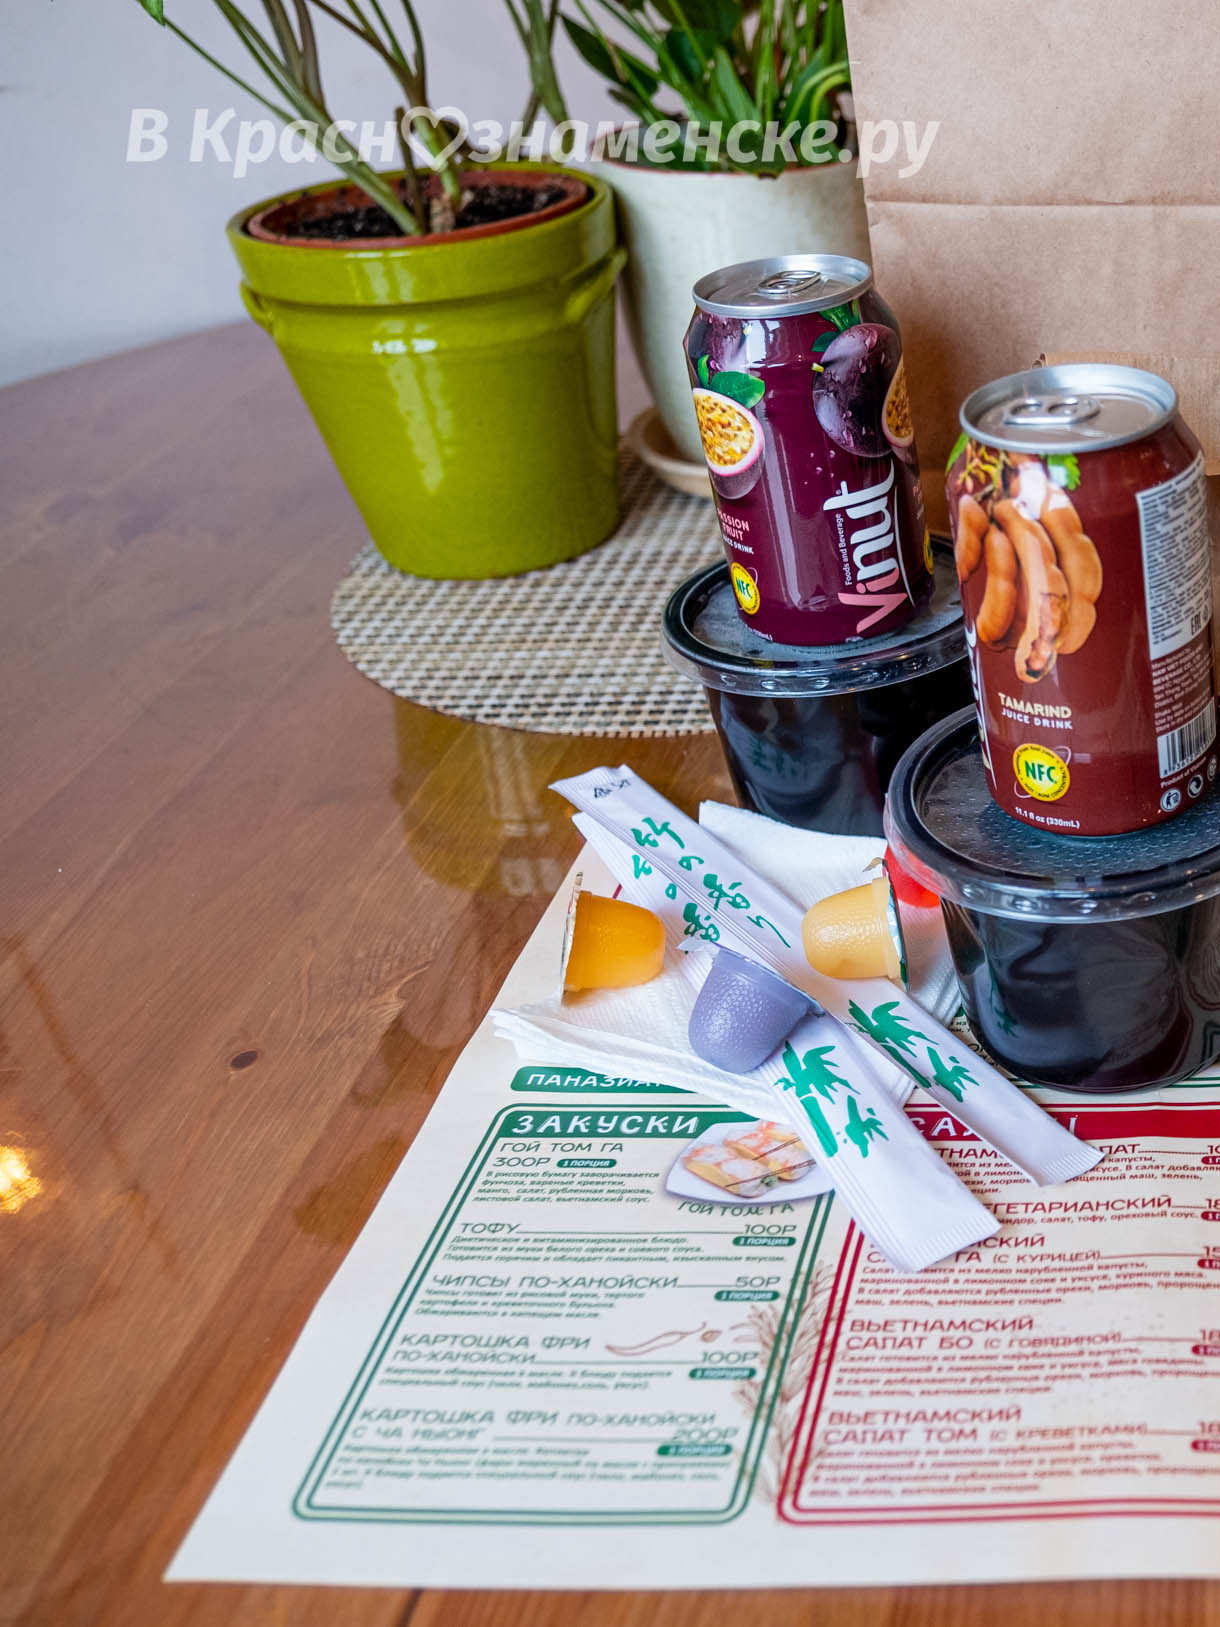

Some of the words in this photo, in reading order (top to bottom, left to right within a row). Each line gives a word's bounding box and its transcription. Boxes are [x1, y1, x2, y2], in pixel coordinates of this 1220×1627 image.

[835, 513, 846, 548] Beverage
[823, 458, 908, 634] Vinut
[845, 560, 853, 586] Foods
[998, 692, 1072, 719] TAMARIND
[1002, 708, 1030, 724] JUICE
[1034, 717, 1073, 729] DRINK
[1024, 760, 1057, 784] NFC
[1015, 806, 1028, 818] 11.1
[527, 1074, 661, 1087] ПАНАЗИА
[512, 1115, 699, 1134] ЗАКУСКИ
[500, 1141, 541, 1153] ГОЙ
[551, 1143, 593, 1152] ТОМ
[600, 1143, 623, 1152] ГА
[1099, 1144, 1140, 1155] ЛАТ
[492, 1157, 551, 1167] 300Р
[678, 1201, 713, 1215] ГОЙ
[720, 1204, 764, 1216] ТОМ
[769, 1203, 795, 1214] ГА
[988, 1195, 1172, 1214] ЕГЕТАРИАНСКИЙ
[460, 1222, 521, 1233] ТОФУ
[744, 1224, 797, 1235] 100Р
[1016, 1250, 1102, 1264] КУРИЦЕЙ)
[432, 1274, 510, 1287] ЧИПСЫ
[519, 1275, 679, 1289] ПО-ХАНОЙСКИ
[736, 1277, 781, 1287] 50Р
[850, 1315, 1034, 1332] ВЬЕТНАМСКИЙ
[400, 1334, 529, 1348] КАРТОШКА
[542, 1336, 591, 1349] ФРИ
[939, 1336, 973, 1349] БО
[393, 1350, 536, 1364] ПО-ХАНОЙСКИ
[701, 1351, 759, 1364] 100Р
[360, 1409, 495, 1424] КАРТОШКА
[506, 1411, 559, 1424] ФРИ
[829, 1405, 1022, 1425] ВЬЕТНАМСКИЙ
[925, 1428, 977, 1442] ТОМ
